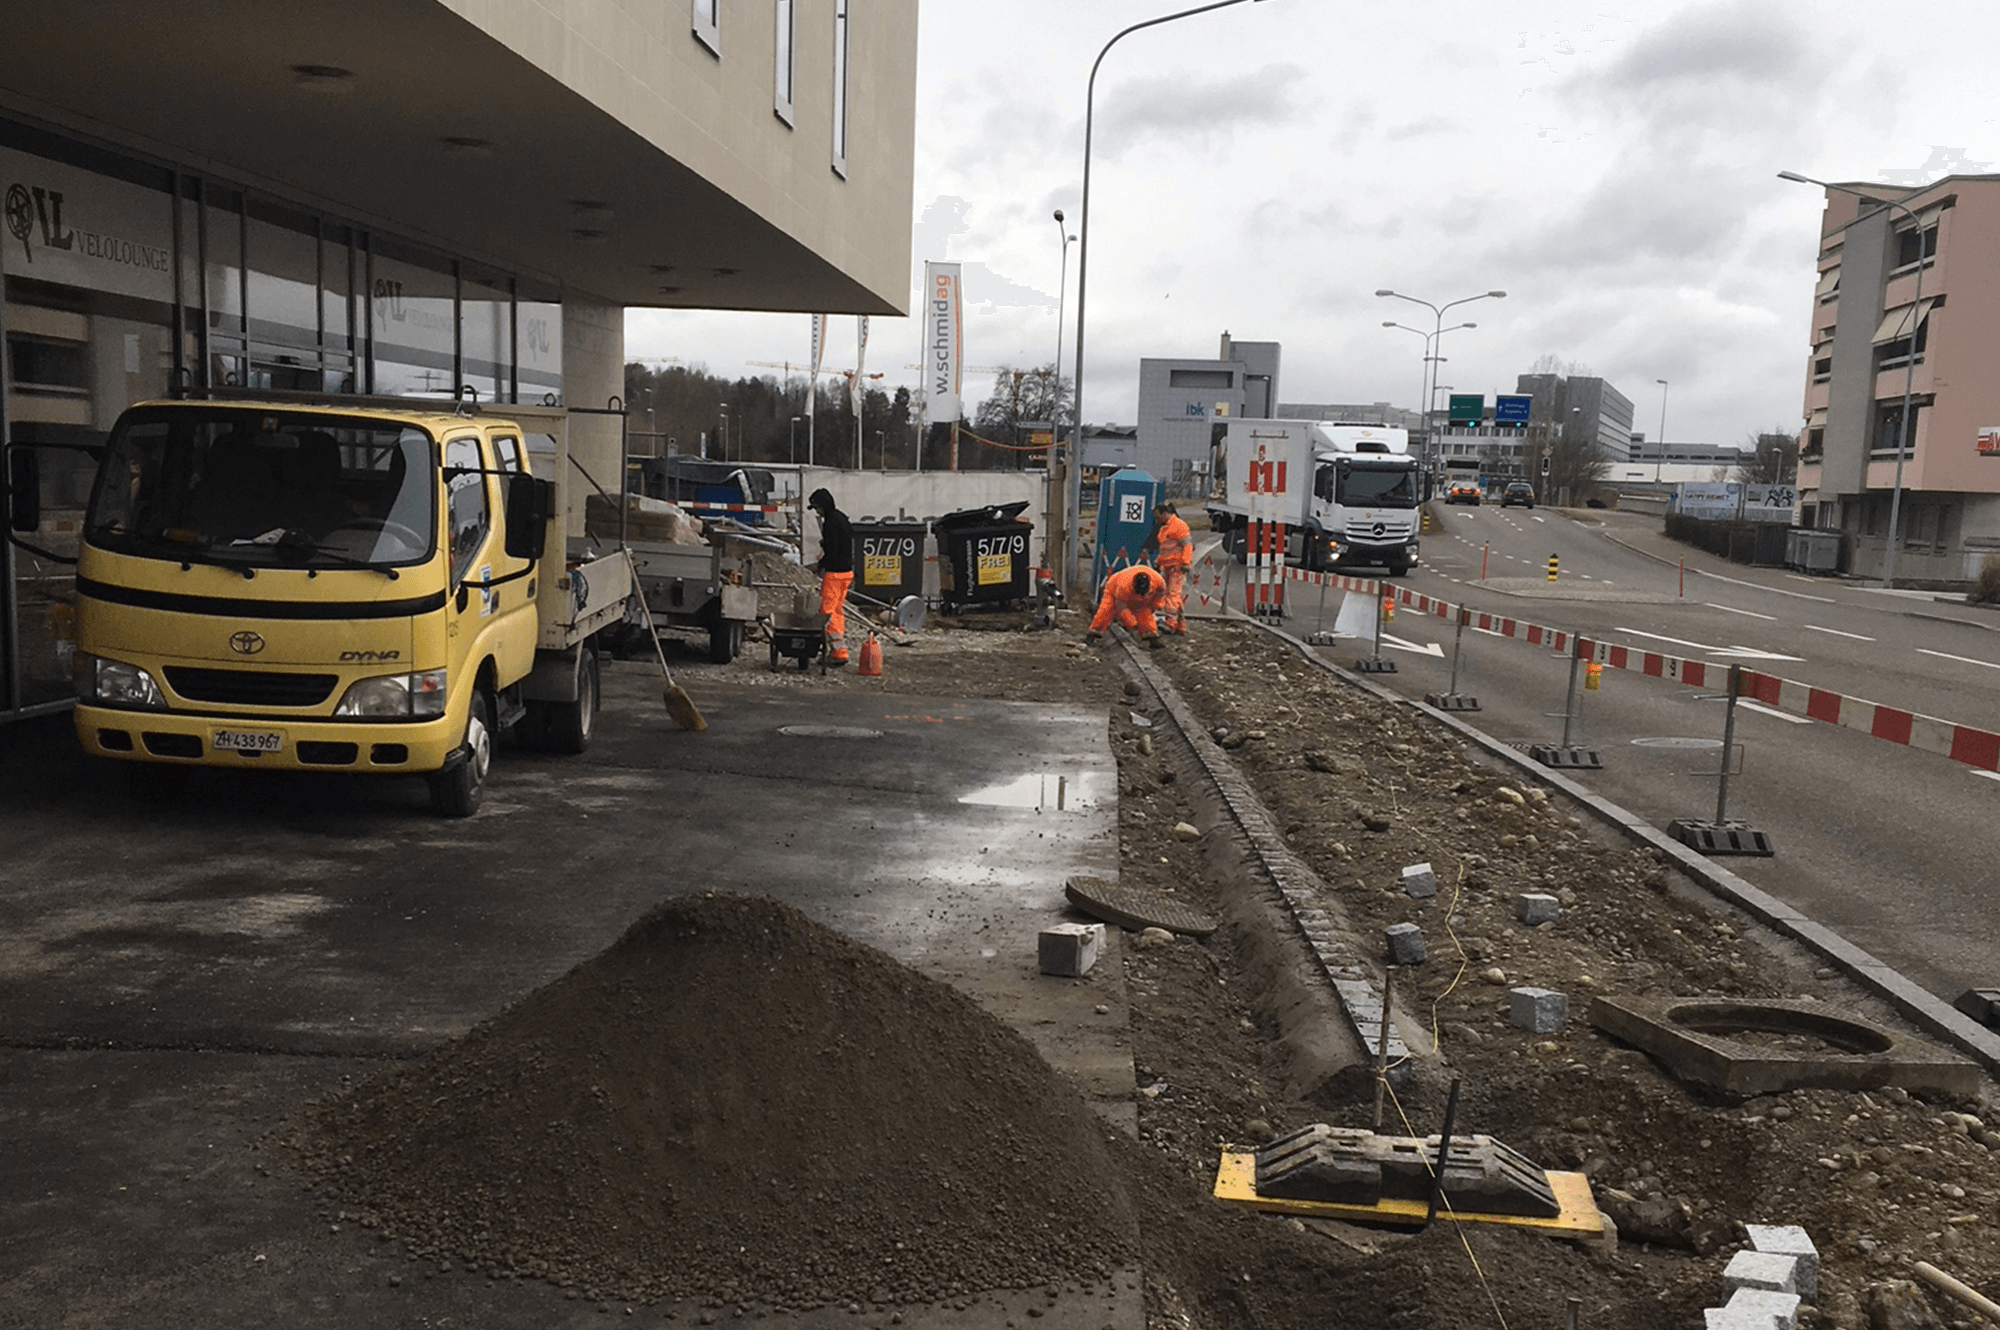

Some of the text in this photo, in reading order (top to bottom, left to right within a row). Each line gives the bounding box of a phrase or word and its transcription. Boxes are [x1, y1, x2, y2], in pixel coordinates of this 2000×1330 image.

[75, 229, 170, 272] VELOLOUNGE
[863, 538, 915, 557] 5/7/9
[977, 535, 1024, 557] 5/7/9
[865, 557, 900, 569] FREI
[979, 555, 1011, 569] FREI
[339, 649, 400, 662] DYNA
